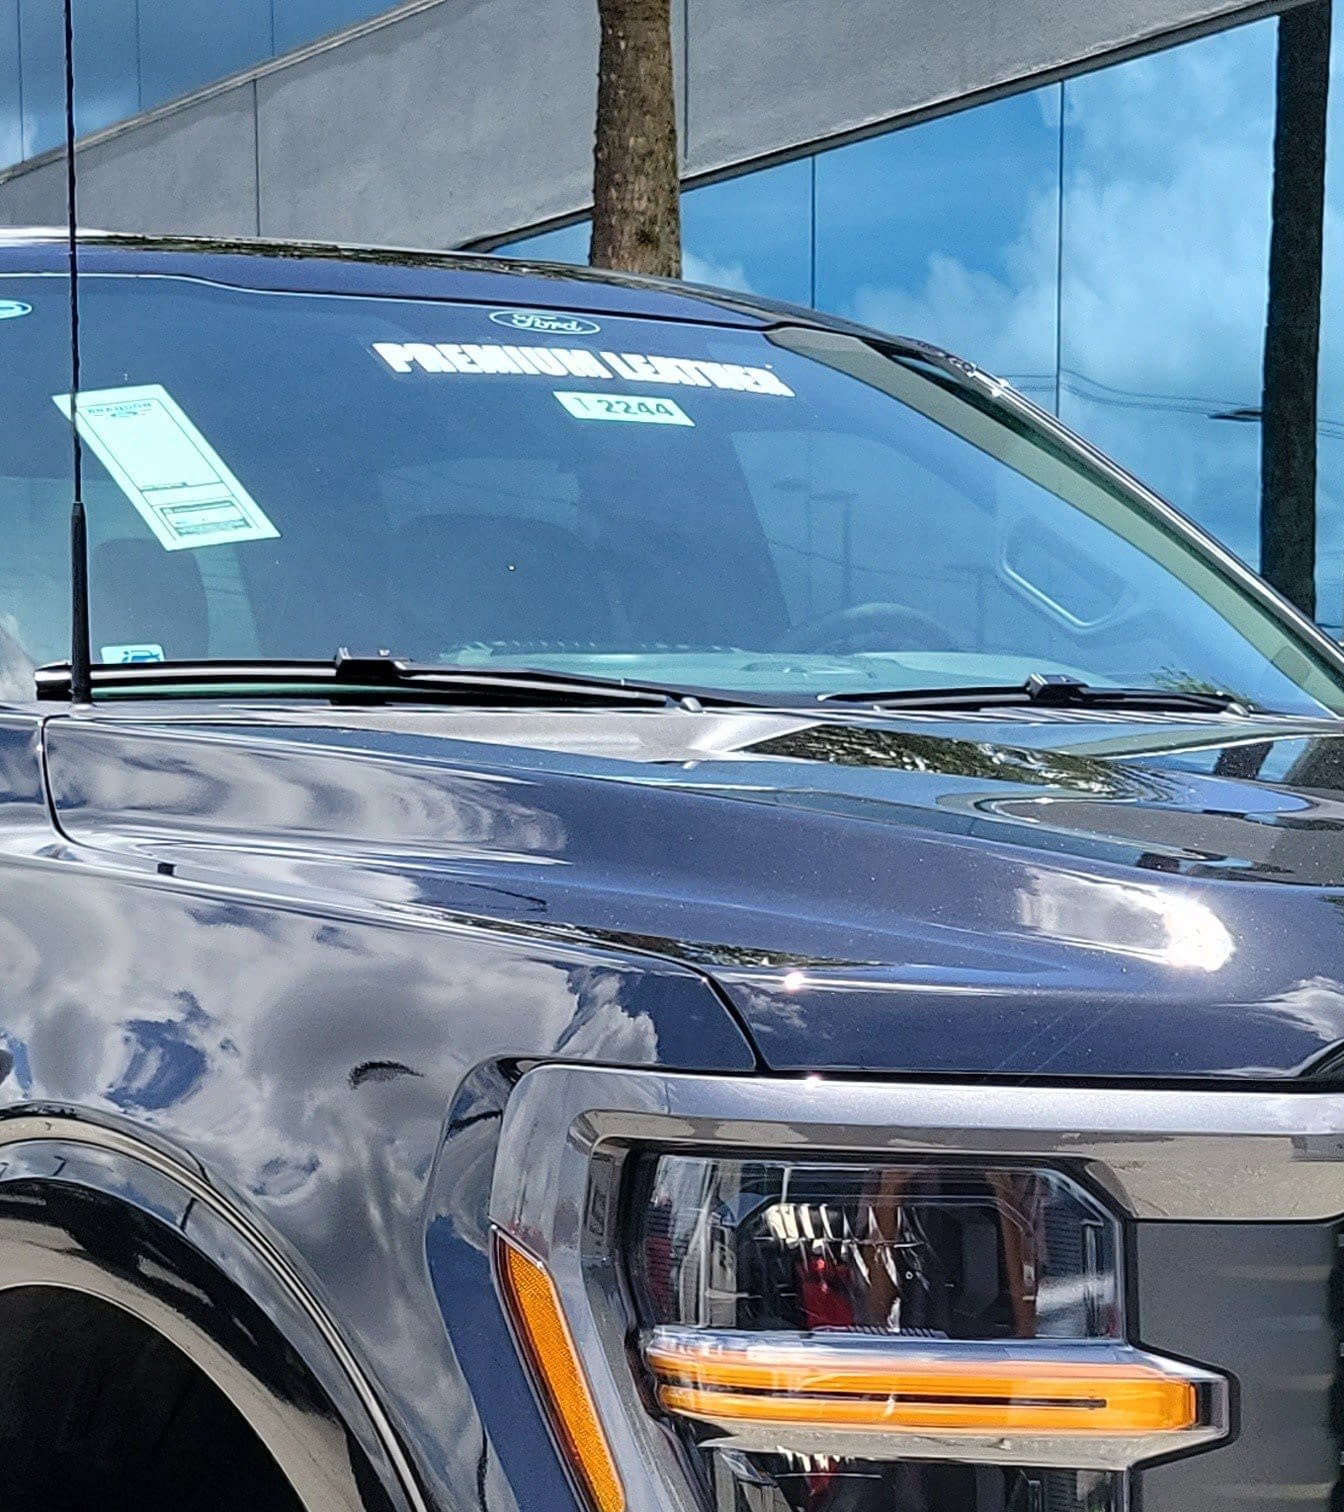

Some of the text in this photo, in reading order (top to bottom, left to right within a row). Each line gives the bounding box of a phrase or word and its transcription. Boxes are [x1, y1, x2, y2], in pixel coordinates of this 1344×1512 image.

[511, 312, 583, 332] Ford
[372, 342, 796, 397] PREMIUM LEATHER
